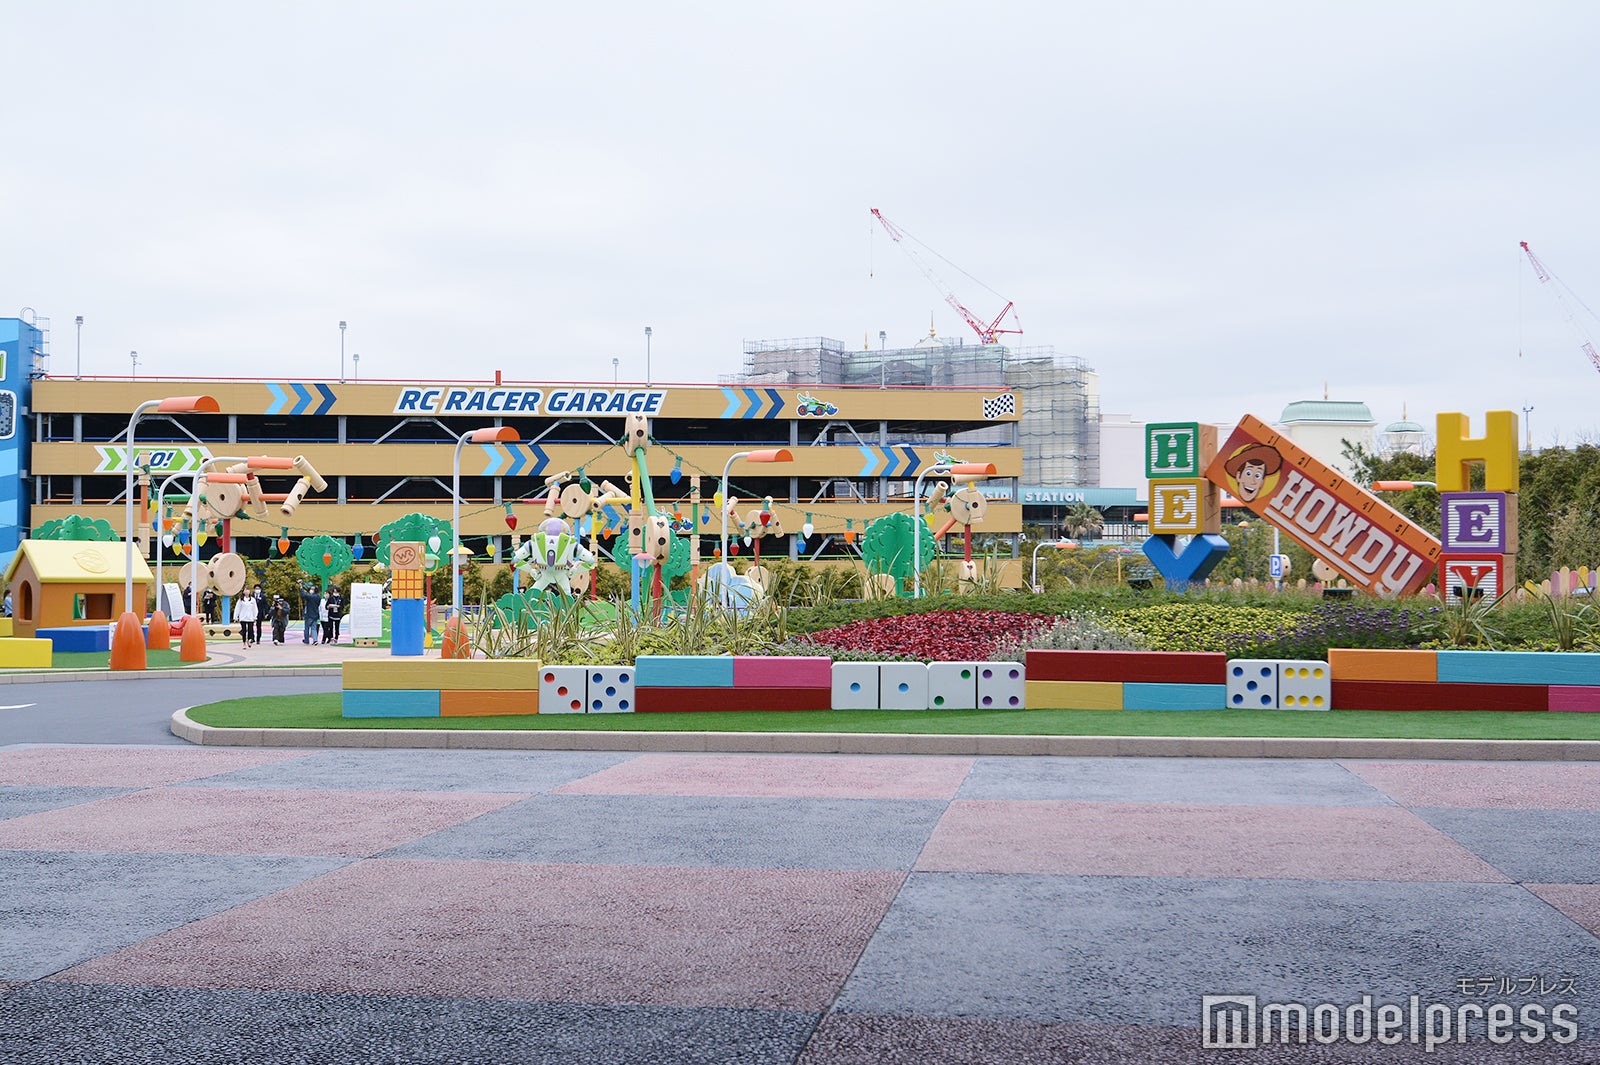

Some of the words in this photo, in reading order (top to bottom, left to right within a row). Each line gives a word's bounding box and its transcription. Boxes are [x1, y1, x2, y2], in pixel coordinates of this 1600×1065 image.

[398, 390, 440, 411] RC
[441, 390, 541, 412] RACER
[547, 392, 662, 413] GARAGE
[1025, 492, 1085, 502] STATION
